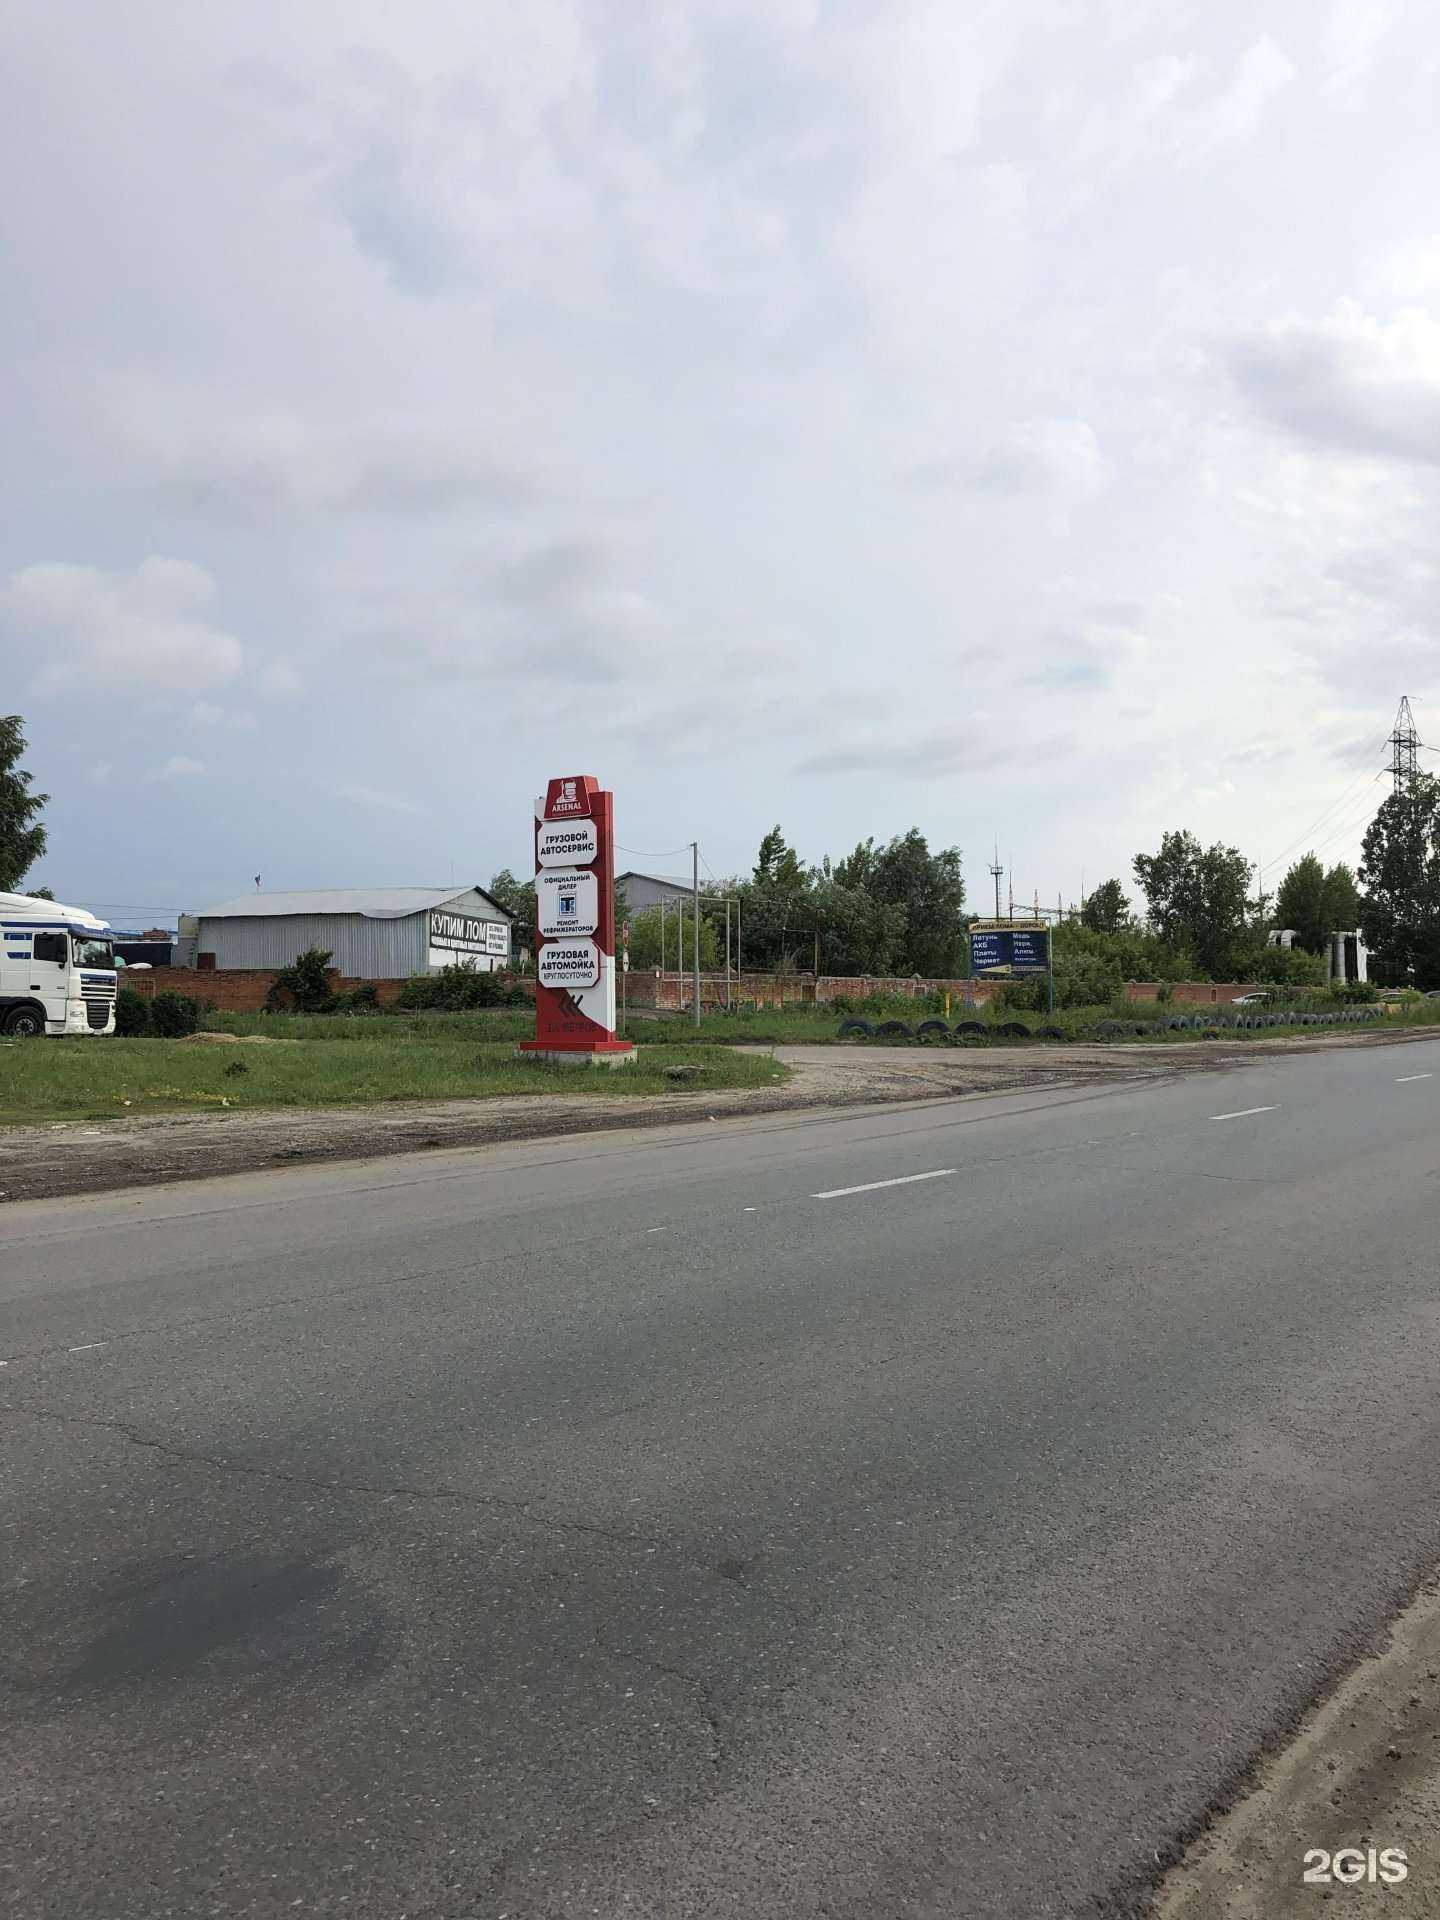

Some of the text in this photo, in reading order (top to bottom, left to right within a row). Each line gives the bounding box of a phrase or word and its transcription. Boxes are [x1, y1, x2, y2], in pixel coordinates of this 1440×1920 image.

[552, 802, 582, 812] ARSENAL
[545, 830, 588, 844] ГРУЗОВОЙ
[540, 842, 595, 856] АВТОСЕРВИС
[544, 874, 591, 884] ОФИЦИАЛЬНЫЙ
[558, 883, 577, 891] ДИЛЕР
[431, 913, 464, 938] КУПИМ
[466, 920, 486, 941] ЛОМ
[543, 925, 594, 934] РЕФРИЖЕРАТОРОВ
[546, 949, 589, 960] ГРУЗОВАЯ
[541, 959, 595, 970] АВТОМОЙКА
[543, 971, 593, 980] КРУГЛОСУТОЧНО
